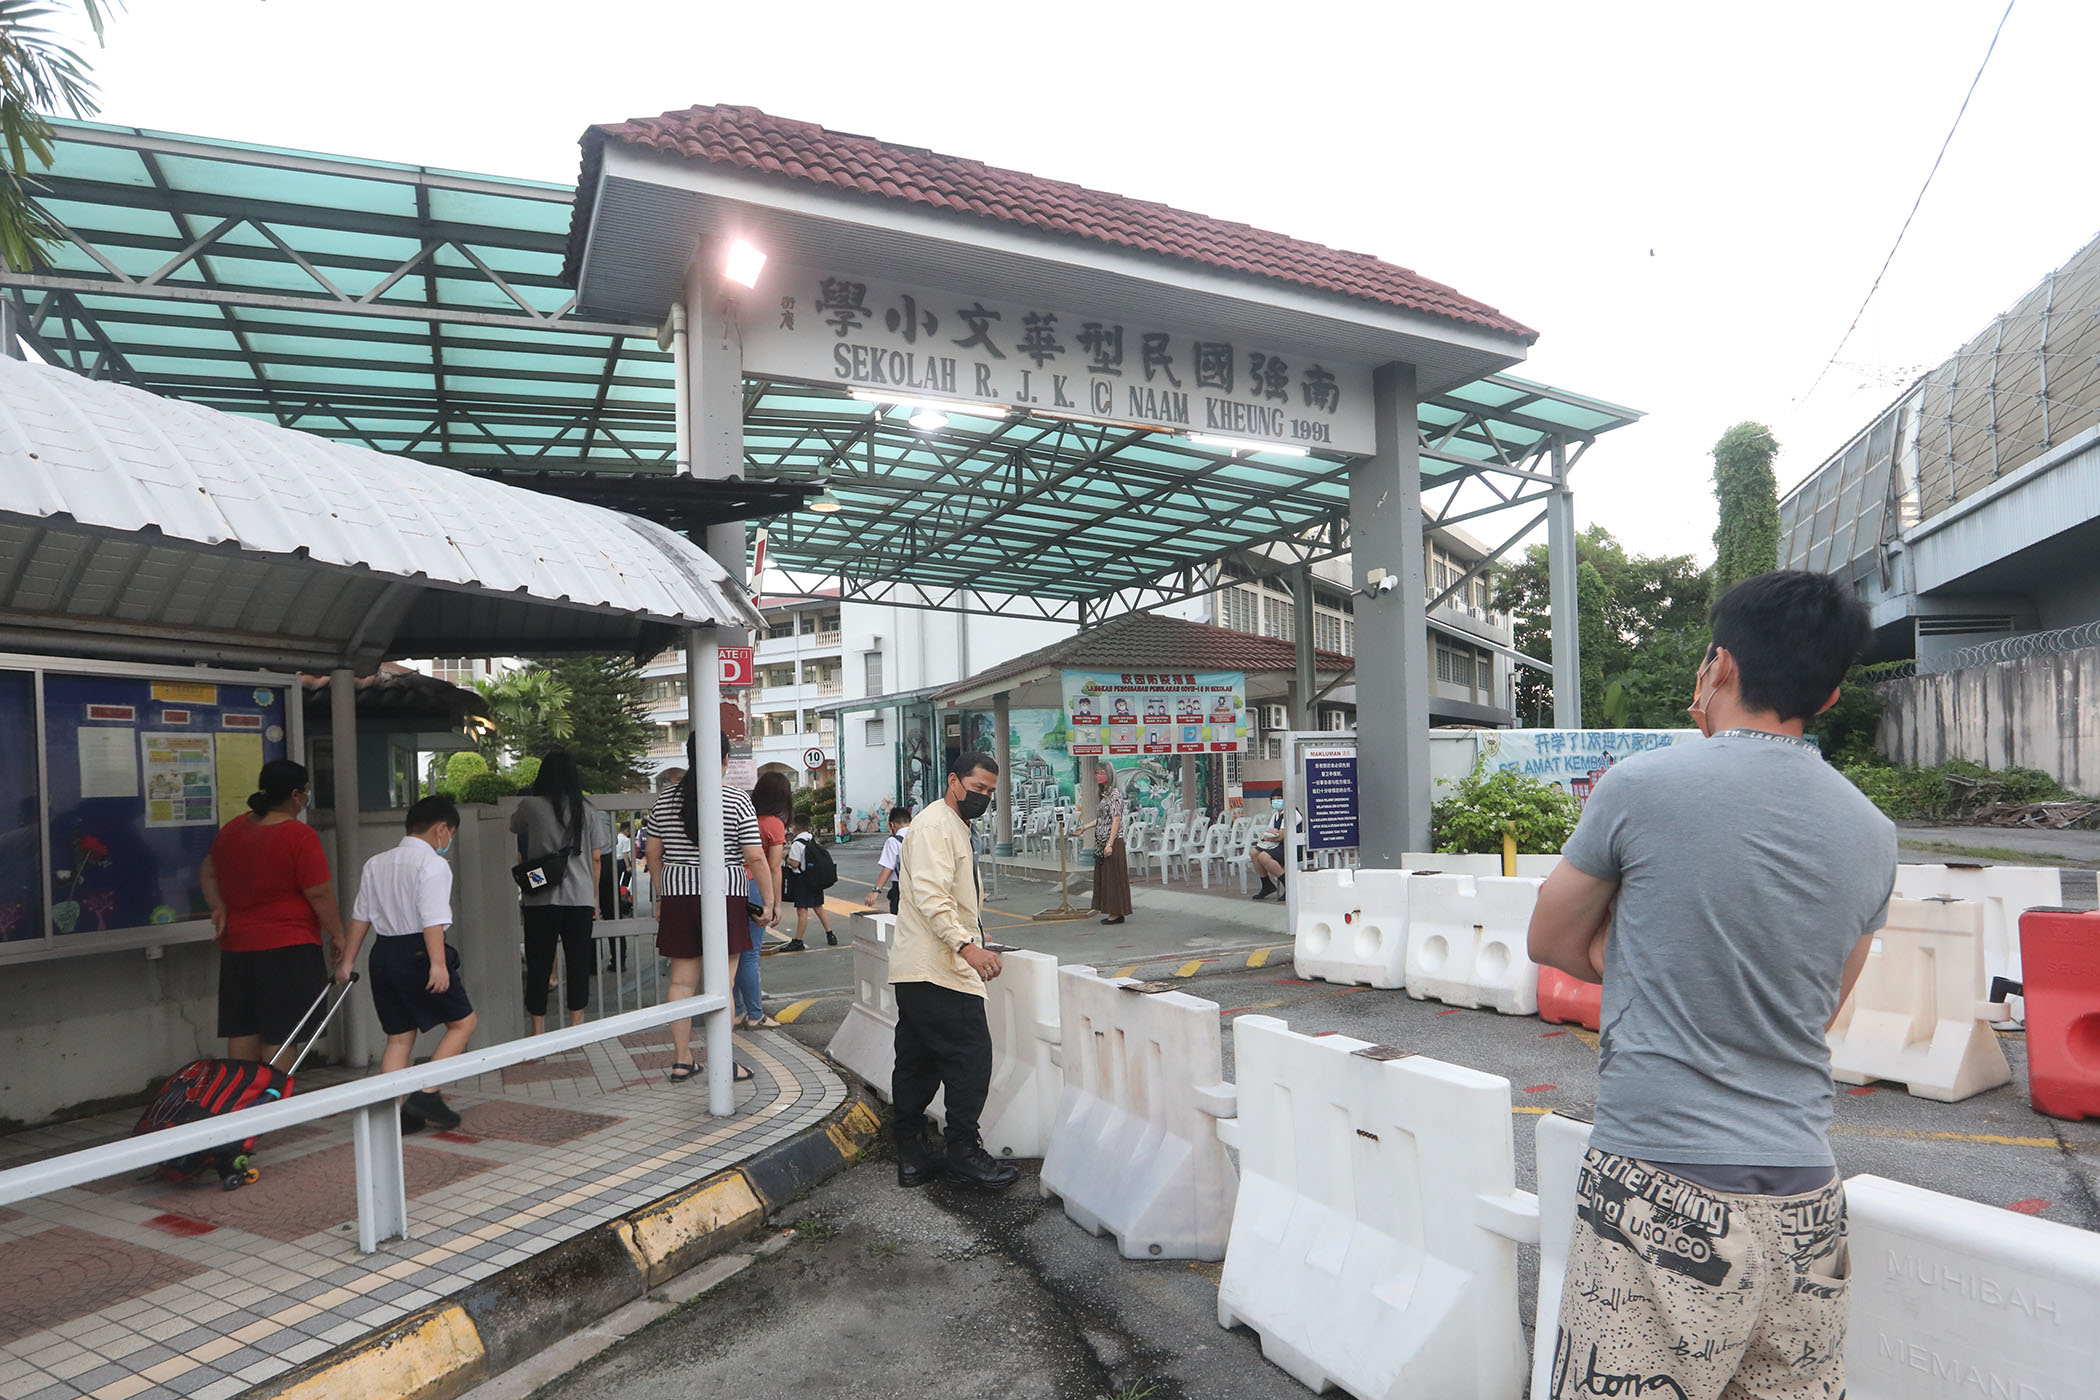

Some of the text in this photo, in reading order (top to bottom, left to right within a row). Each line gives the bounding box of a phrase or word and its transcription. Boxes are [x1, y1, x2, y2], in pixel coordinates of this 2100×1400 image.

[833, 342, 957, 393] SEKOLAH
[974, 362, 999, 398] R.
[1016, 369, 1038, 403] J.
[1053, 375, 1075, 408] K.
[1129, 385, 1190, 425] NAAM
[1205, 397, 1284, 438] KHEUNG
[1290, 418, 1332, 444] 1991
[807, 752, 820, 762] 10
[1887, 1249, 2061, 1326] MUHIBAH
[1879, 1332, 2056, 1400] MEMAND
